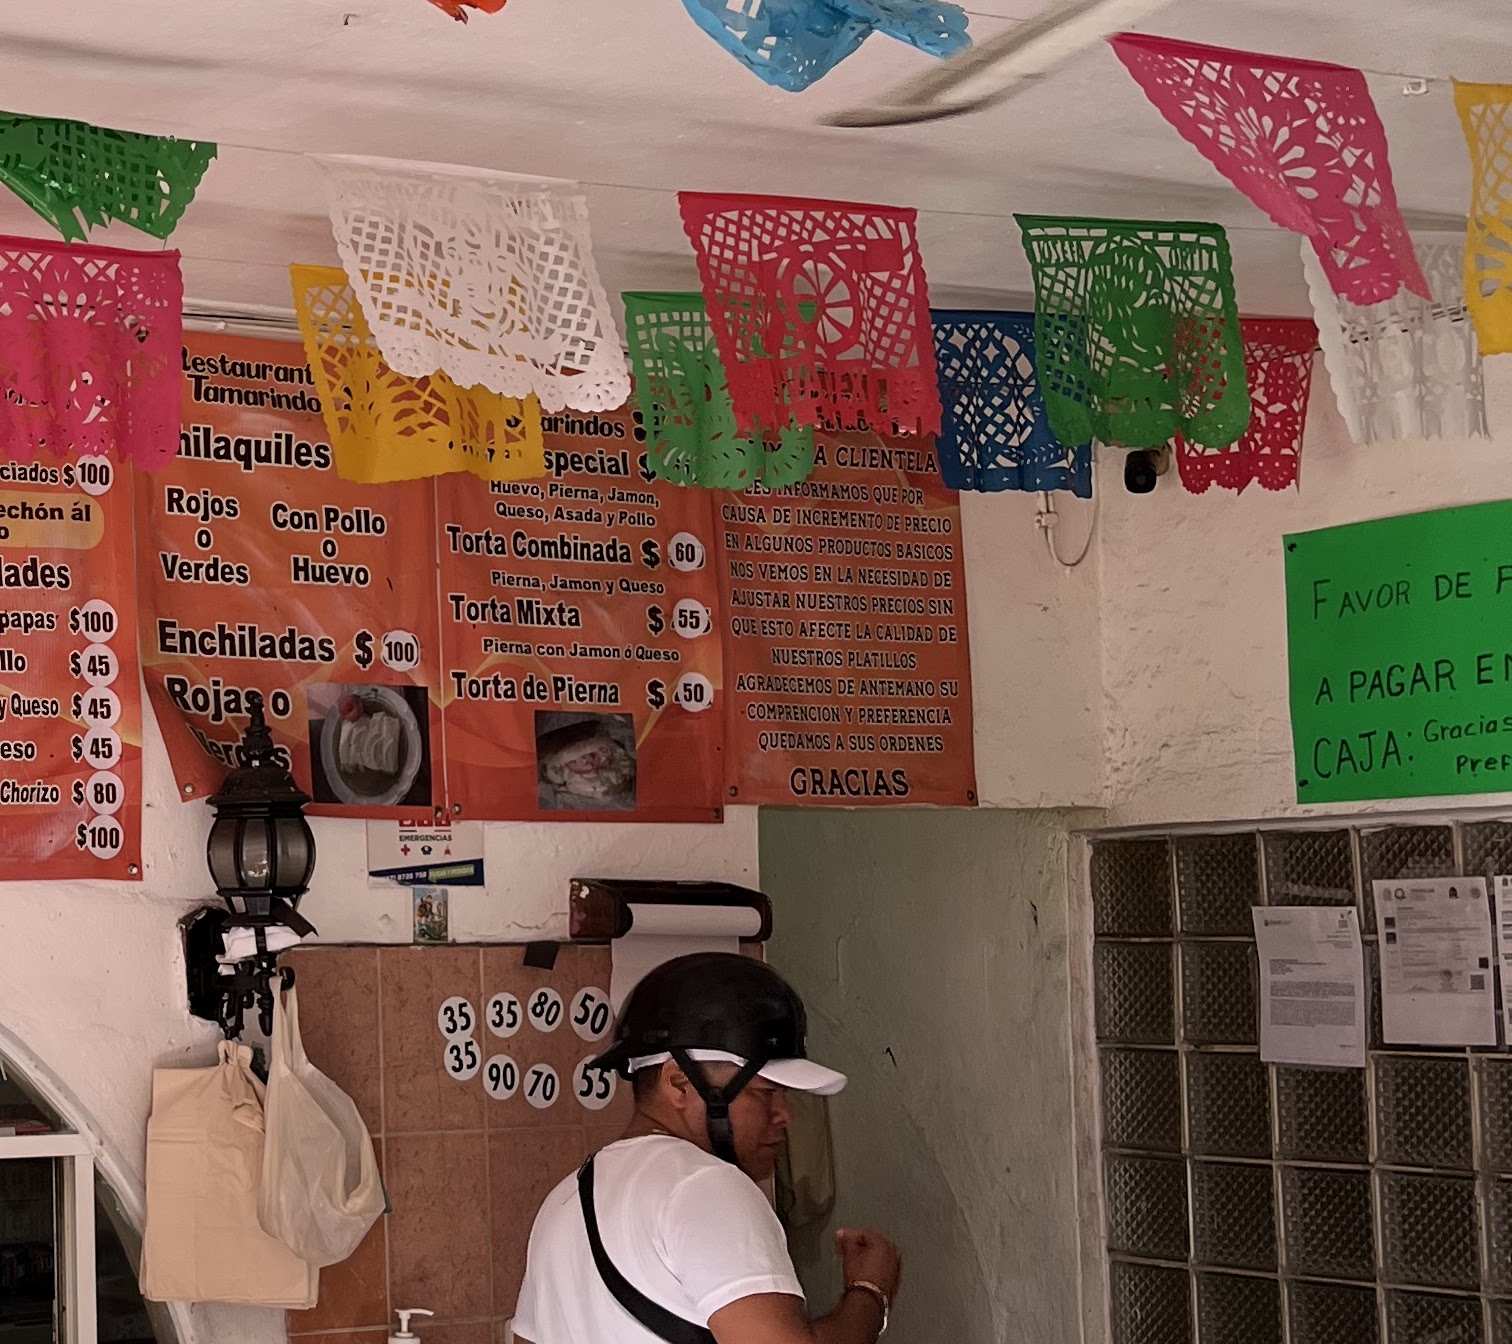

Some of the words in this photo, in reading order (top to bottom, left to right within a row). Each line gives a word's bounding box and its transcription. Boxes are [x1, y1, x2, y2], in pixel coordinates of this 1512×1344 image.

[187, 374, 321, 413] Tamarindo
[177, 424, 331, 471] hilaquiles
[836, 446, 938, 473] CLIENTELA
[544, 450, 630, 477] special
[166, 487, 239, 523] Rojos
[491, 480, 545, 500] Huevo,
[549, 484, 604, 503] Pierna,
[608, 488, 660, 507] Jamon,
[272, 504, 319, 533] Con
[325, 507, 386, 536] Pollo
[496, 503, 549, 522] Queso,
[554, 506, 602, 523] Asada
[606, 512, 614, 527] y
[619, 512, 656, 527] Pollo
[722, 505, 766, 524] CAUSA
[773, 508, 790, 524] DE
[797, 509, 882, 528] INCREMENTO
[888, 515, 899, 530] DE
[905, 516, 952, 534] PRECIO
[197, 529, 212, 550] o
[323, 539, 337, 559] o
[447, 526, 506, 555] Torta
[513, 531, 633, 563] Combinada
[725, 533, 739, 549] EN
[745, 533, 813, 553] ALGUNOS
[819, 537, 891, 557] PRODUCTOS
[896, 544, 953, 560] BASICOS
[162, 554, 249, 585] Verdes
[292, 558, 369, 586] Huevo
[492, 572, 546, 591] Pierna,
[550, 576, 601, 592] Jamon
[606, 580, 614, 595] y
[619, 579, 664, 595] Queso
[732, 589, 790, 608] AJUSTAR
[796, 593, 866, 611] NUESTROS
[872, 597, 924, 614] PRECIOS
[929, 599, 953, 615] SIN
[1313, 579, 1411, 619] FAVOR
[1435, 572, 1472, 601] DE
[449, 595, 511, 623] Torta
[516, 598, 581, 627] Mixta
[158, 619, 335, 662] Enchiladas
[483, 639, 532, 655] Pierna
[537, 643, 565, 656] con
[569, 644, 620, 659] Jamon
[636, 646, 680, 661] Queso
[772, 648, 842, 666] NUESTROS
[848, 651, 916, 669] PLATILLOS
[452, 672, 516, 699] Torta
[523, 675, 548, 701] de
[553, 676, 619, 703] Pierna
[737, 675, 832, 694] AGRADECEMOS
[838, 680, 854, 695] DE
[860, 680, 934, 697] ANTEMANO
[941, 682, 958, 696] SU
[1315, 678, 1333, 705] A
[1350, 659, 1456, 703] PAGAR
[271, 690, 290, 716] o
[748, 703, 840, 722] COMPRENCION
[845, 708, 853, 722] Y
[859, 708, 952, 724] PREFERENCIA
[759, 733, 830, 751] QUEDAMOS
[836, 735, 844, 750] A
[849, 735, 874, 751] SUS
[880, 736, 943, 752] ORDENES
[791, 768, 909, 796] GRACIAS
[444, 1002, 470, 1033] 35
[492, 1000, 517, 1028] 35
[531, 992, 560, 1026] 80
[574, 993, 608, 1034] 50
[450, 1041, 477, 1072] 35
[488, 1063, 515, 1091] 90
[528, 1070, 555, 1101] 70
[579, 1064, 611, 1099] 55
